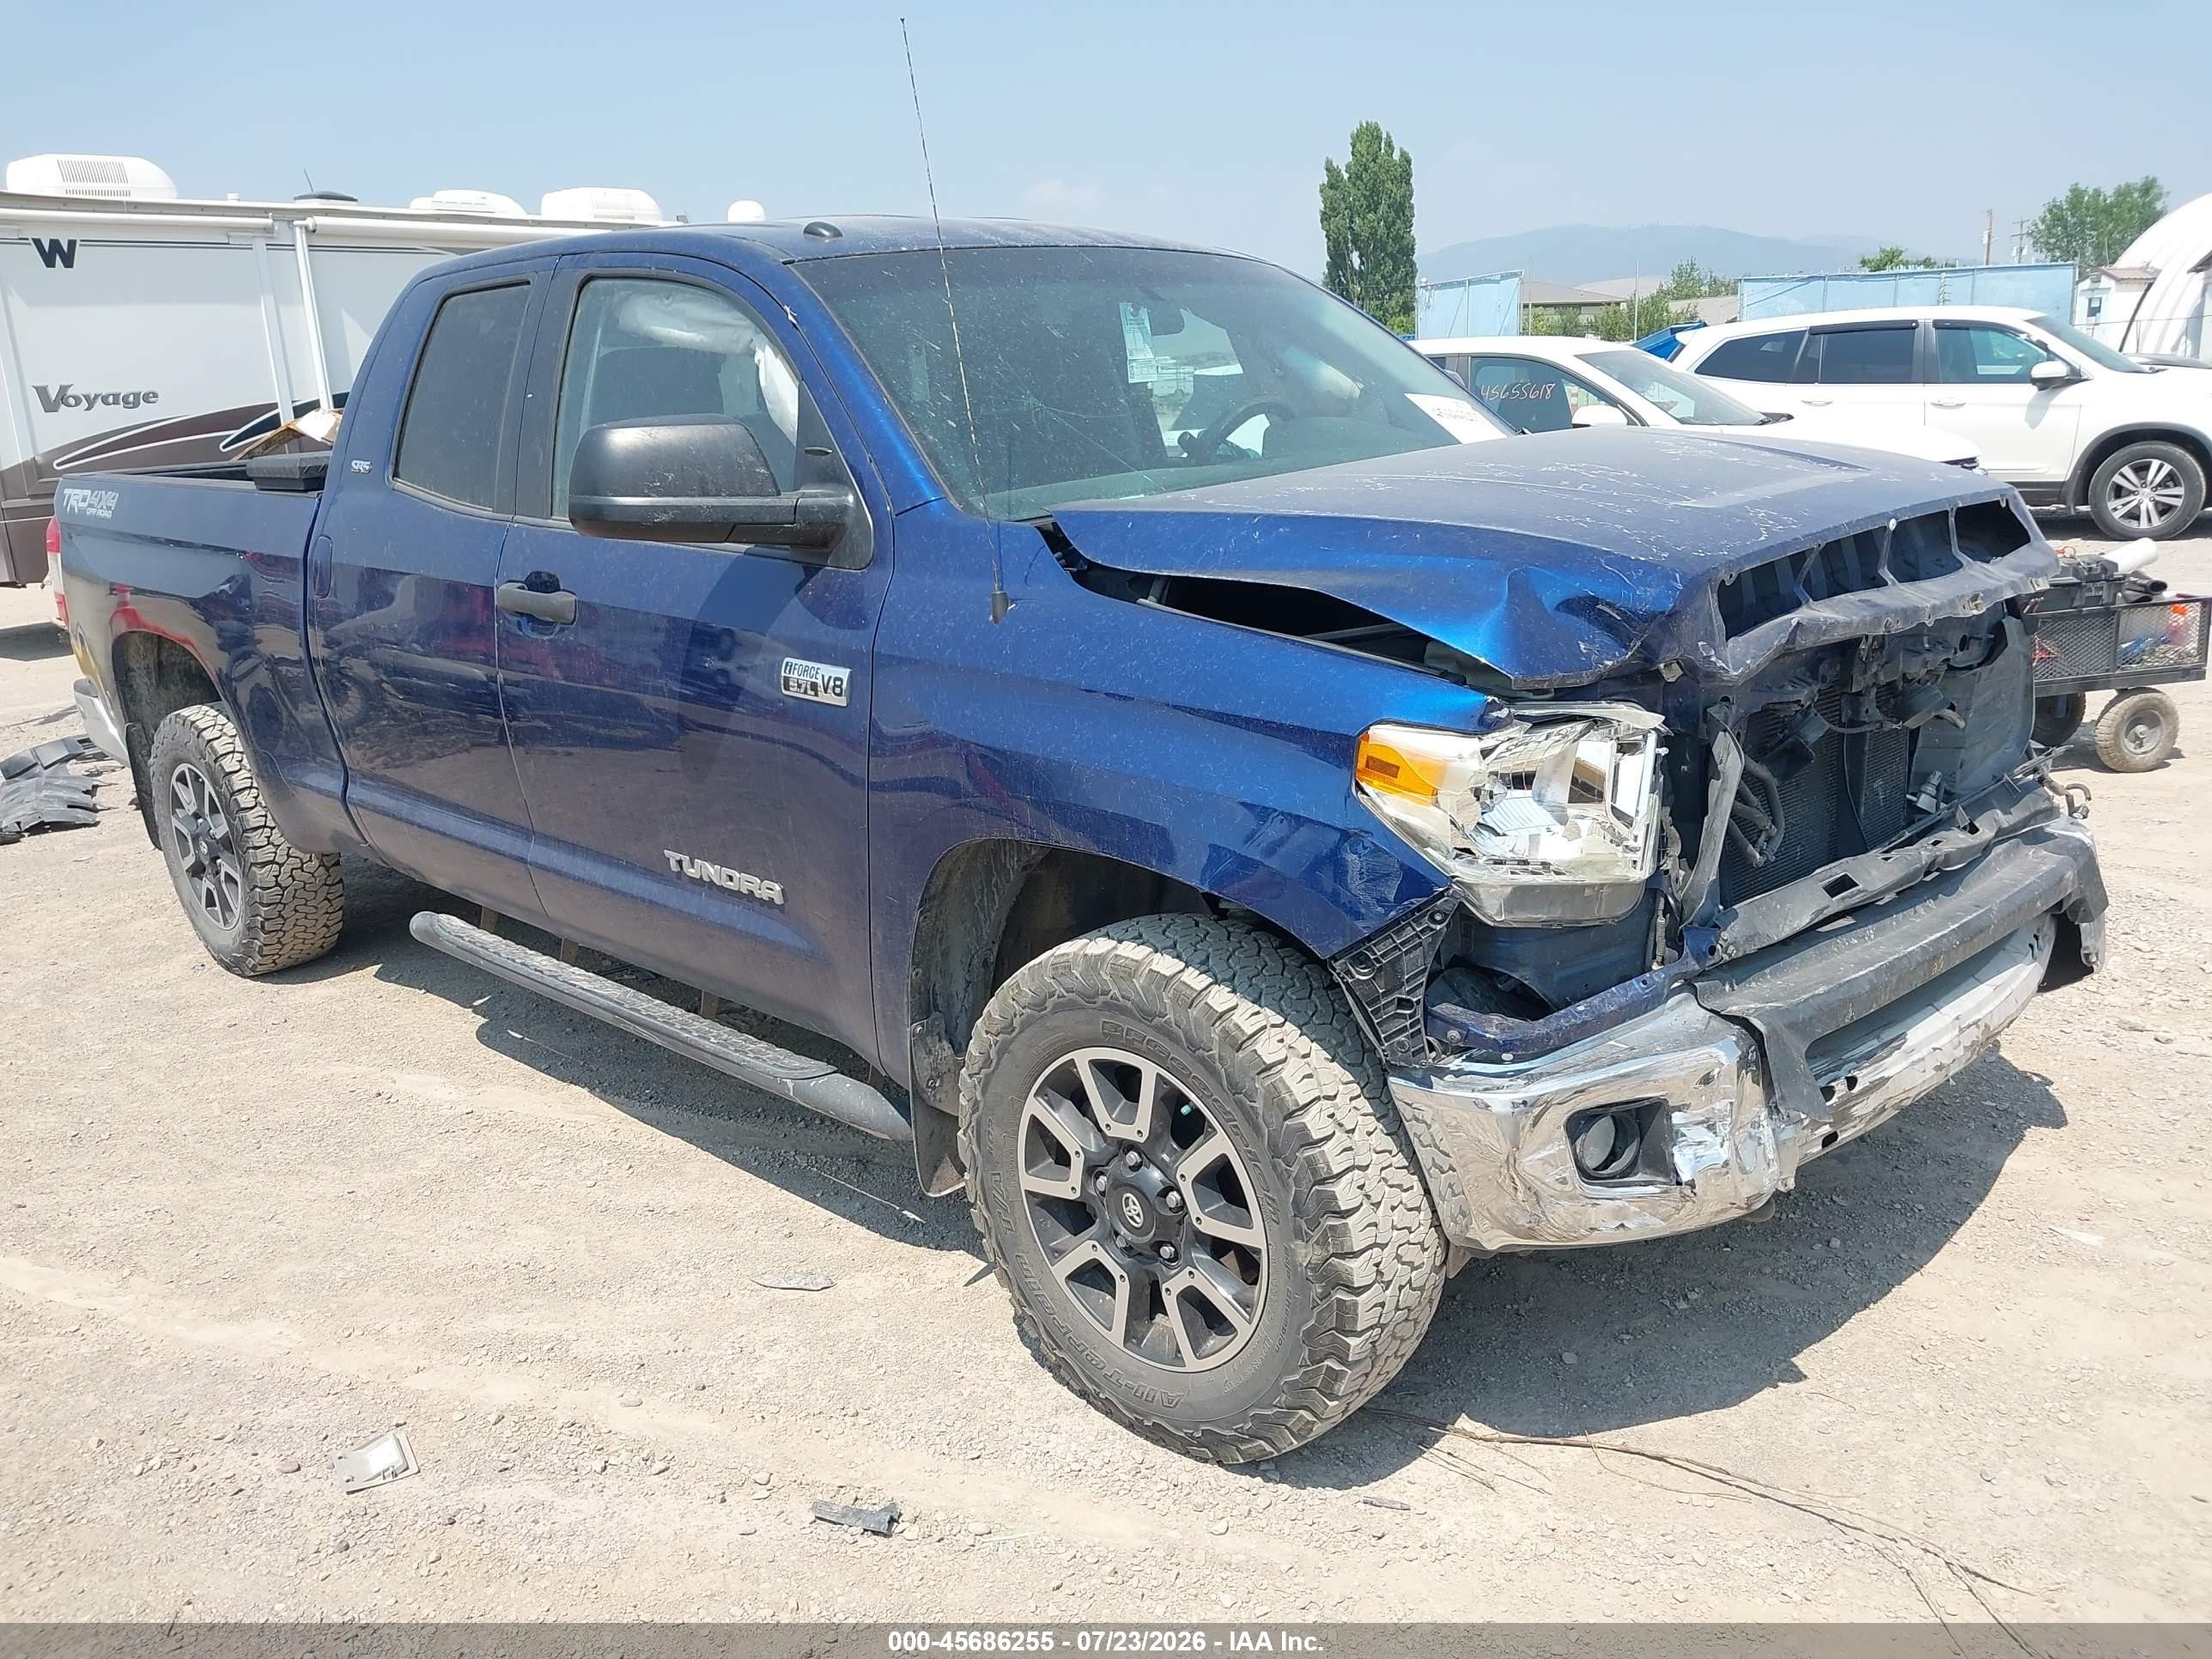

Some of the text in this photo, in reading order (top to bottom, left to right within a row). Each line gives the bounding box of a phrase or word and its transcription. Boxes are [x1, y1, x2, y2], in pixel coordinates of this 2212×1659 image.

[31, 238, 77, 269] W
[31, 383, 159, 413] Voyage
[1480, 383, 1556, 400] 45655618
[63, 488, 92, 514] TRD
[821, 673, 844, 697] V8
[663, 849, 785, 906] TUNDRA
